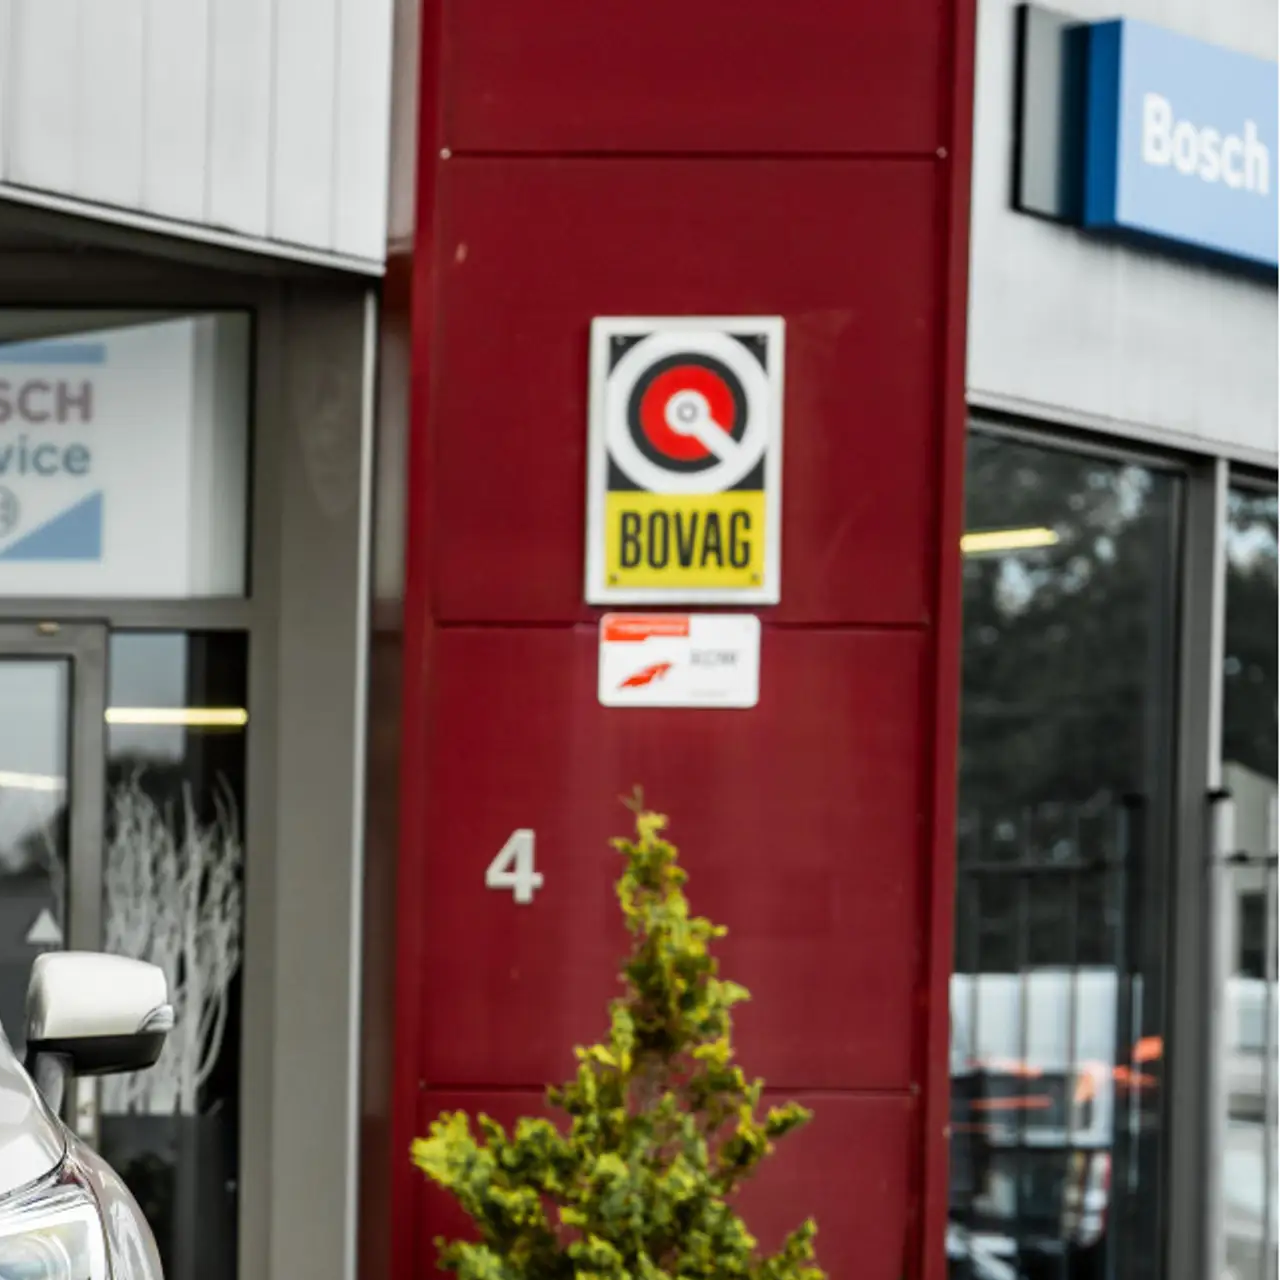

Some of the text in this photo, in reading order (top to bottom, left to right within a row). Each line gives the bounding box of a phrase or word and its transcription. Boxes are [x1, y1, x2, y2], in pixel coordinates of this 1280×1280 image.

[1142, 92, 1269, 195] Bosch
[618, 509, 753, 570] BOVAG
[485, 828, 544, 904] 4
